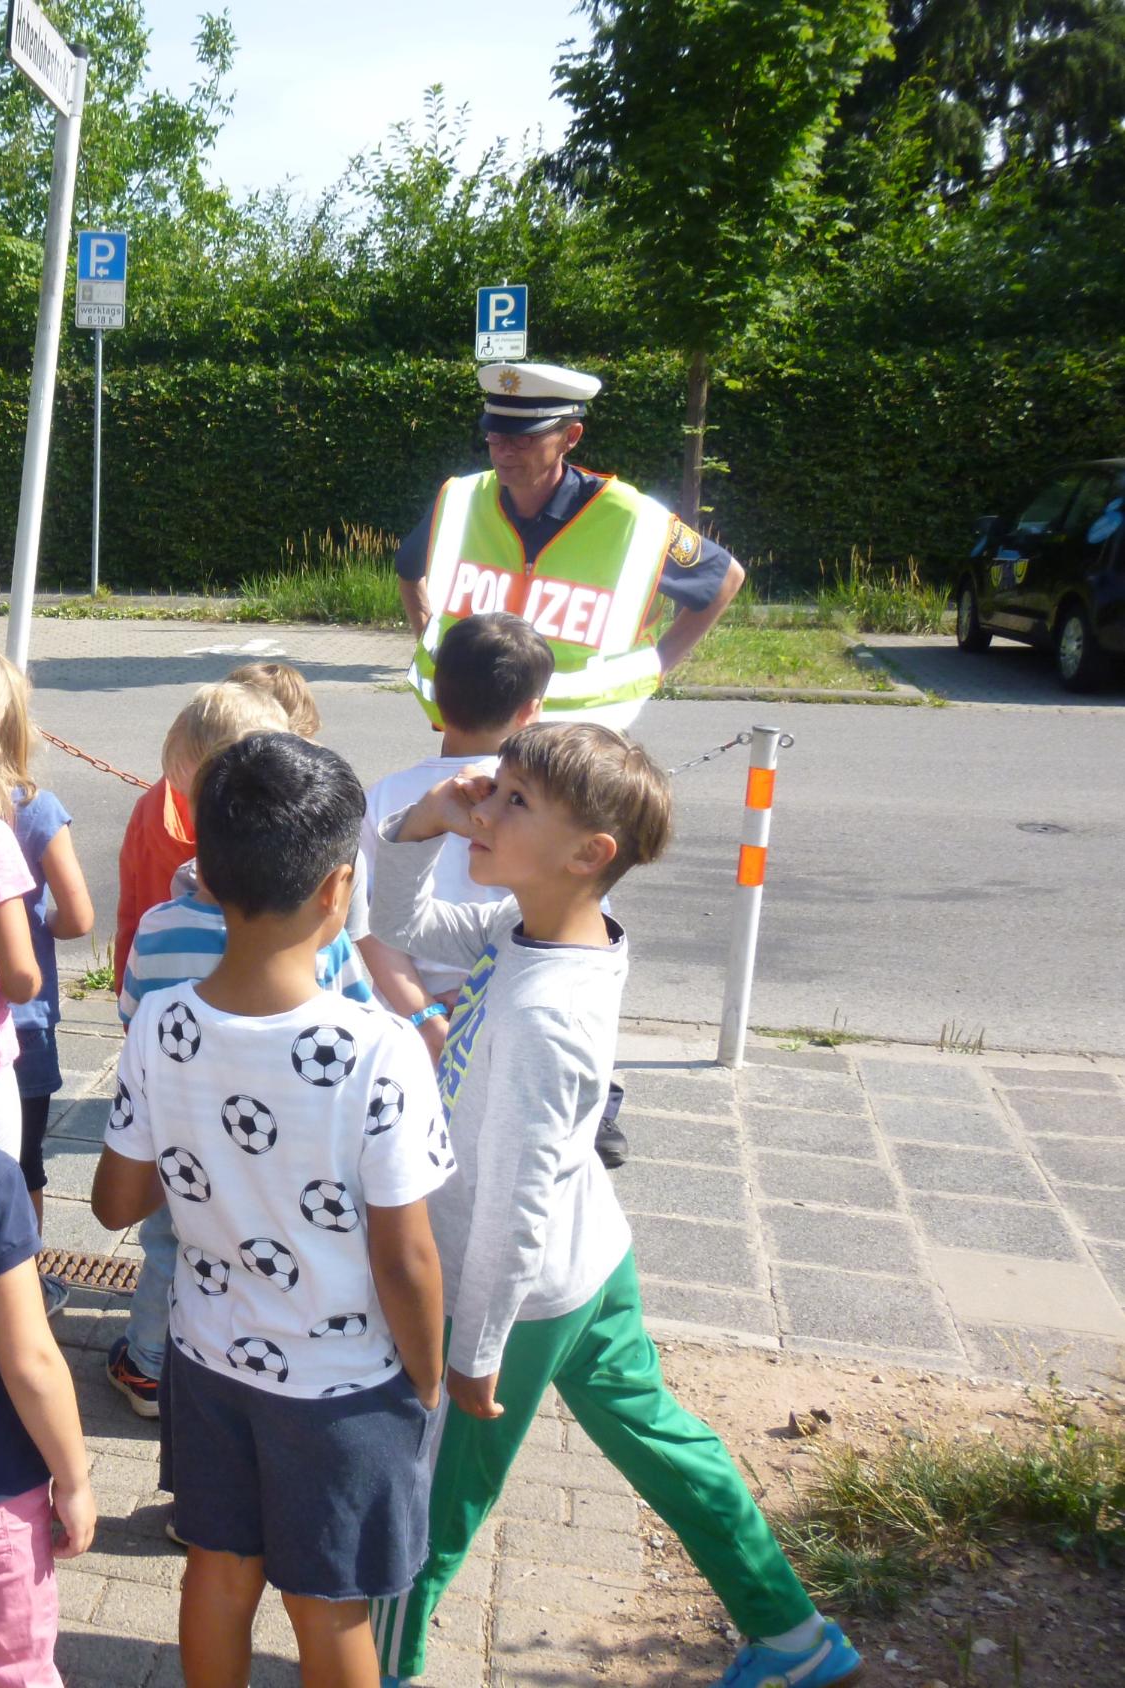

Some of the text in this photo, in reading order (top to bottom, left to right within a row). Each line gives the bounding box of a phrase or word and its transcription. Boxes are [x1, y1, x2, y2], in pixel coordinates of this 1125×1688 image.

[90, 239, 115, 277] P
[80, 306, 121, 317] werktags
[489, 293, 515, 330] P
[448, 562, 611, 646] POLIZEI
